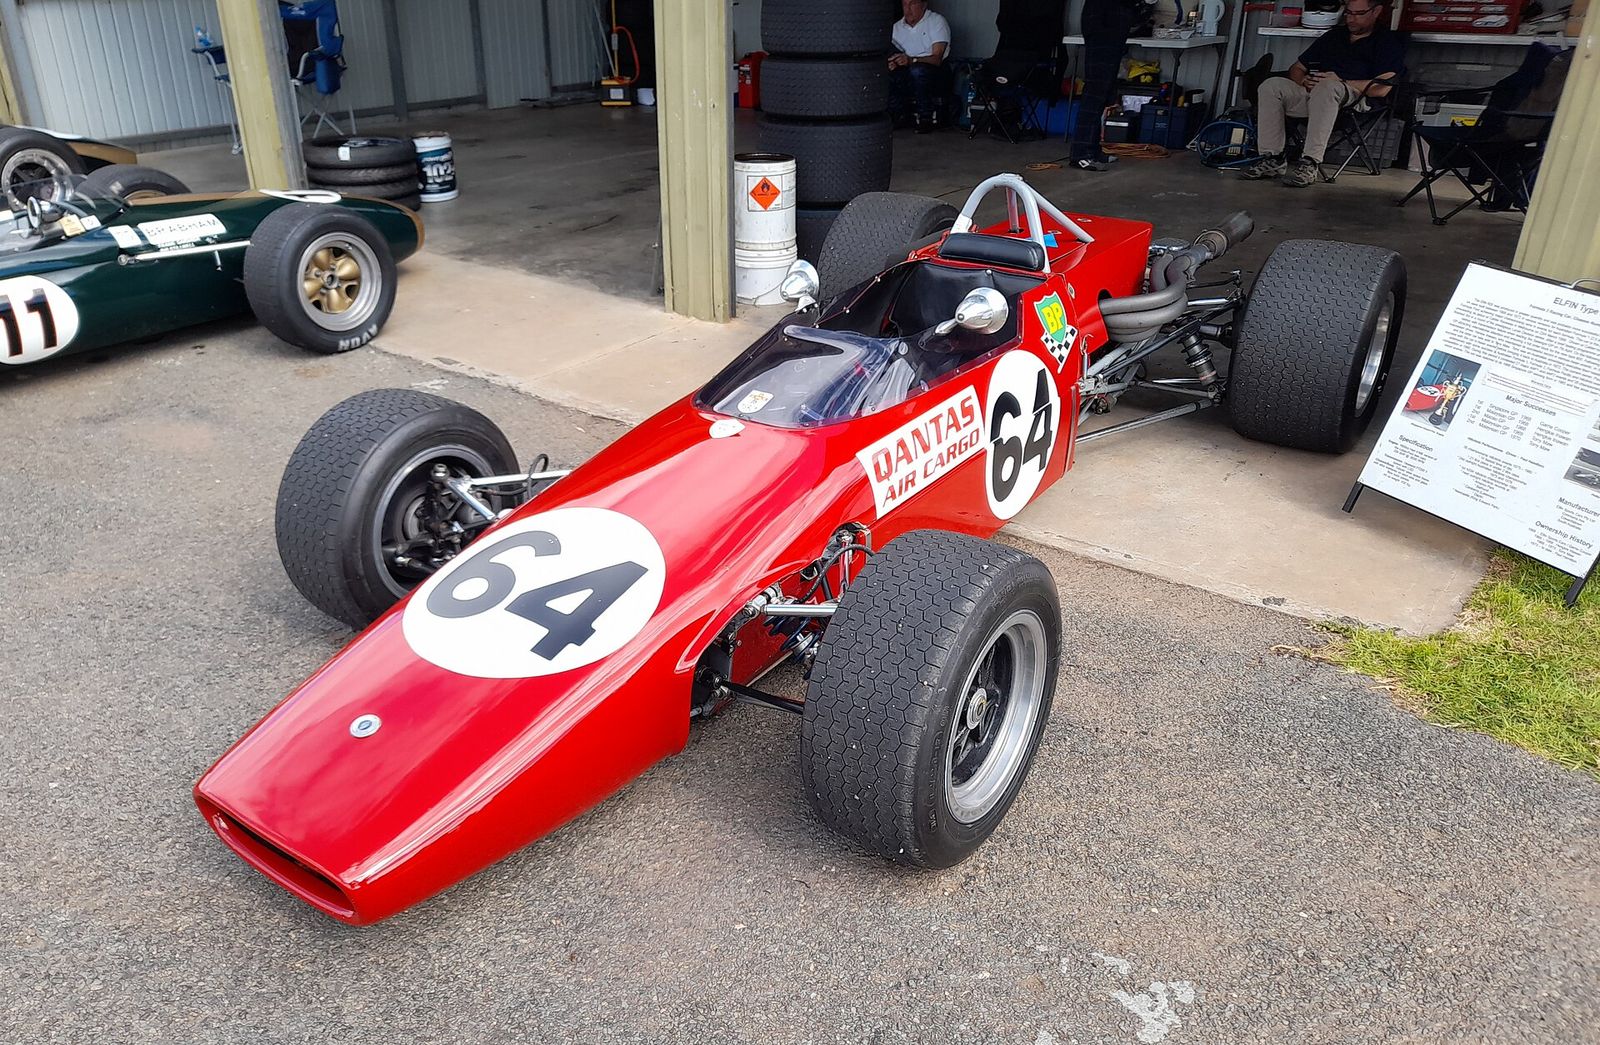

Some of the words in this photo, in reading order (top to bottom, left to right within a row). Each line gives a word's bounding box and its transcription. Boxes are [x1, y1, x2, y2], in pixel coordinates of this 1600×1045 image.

[144, 217, 218, 238] BRABHAM
[1041, 301, 1064, 333] BP
[1553, 297, 1579, 309] ELFIN
[1580, 303, 1599, 315] Type
[0, 287, 58, 358] 11
[338, 323, 378, 352] AVON
[1505, 394, 1523, 404] Major
[1523, 400, 1557, 416] Successes
[872, 395, 975, 485] QANTAS
[990, 367, 1053, 503] 64
[1399, 434, 1433, 452] Specification
[883, 470, 917, 508] AIR
[923, 428, 980, 480] CARGO
[1535, 520, 1569, 539] Ownership
[1569, 535, 1593, 549] History
[426, 530, 649, 661] 64
